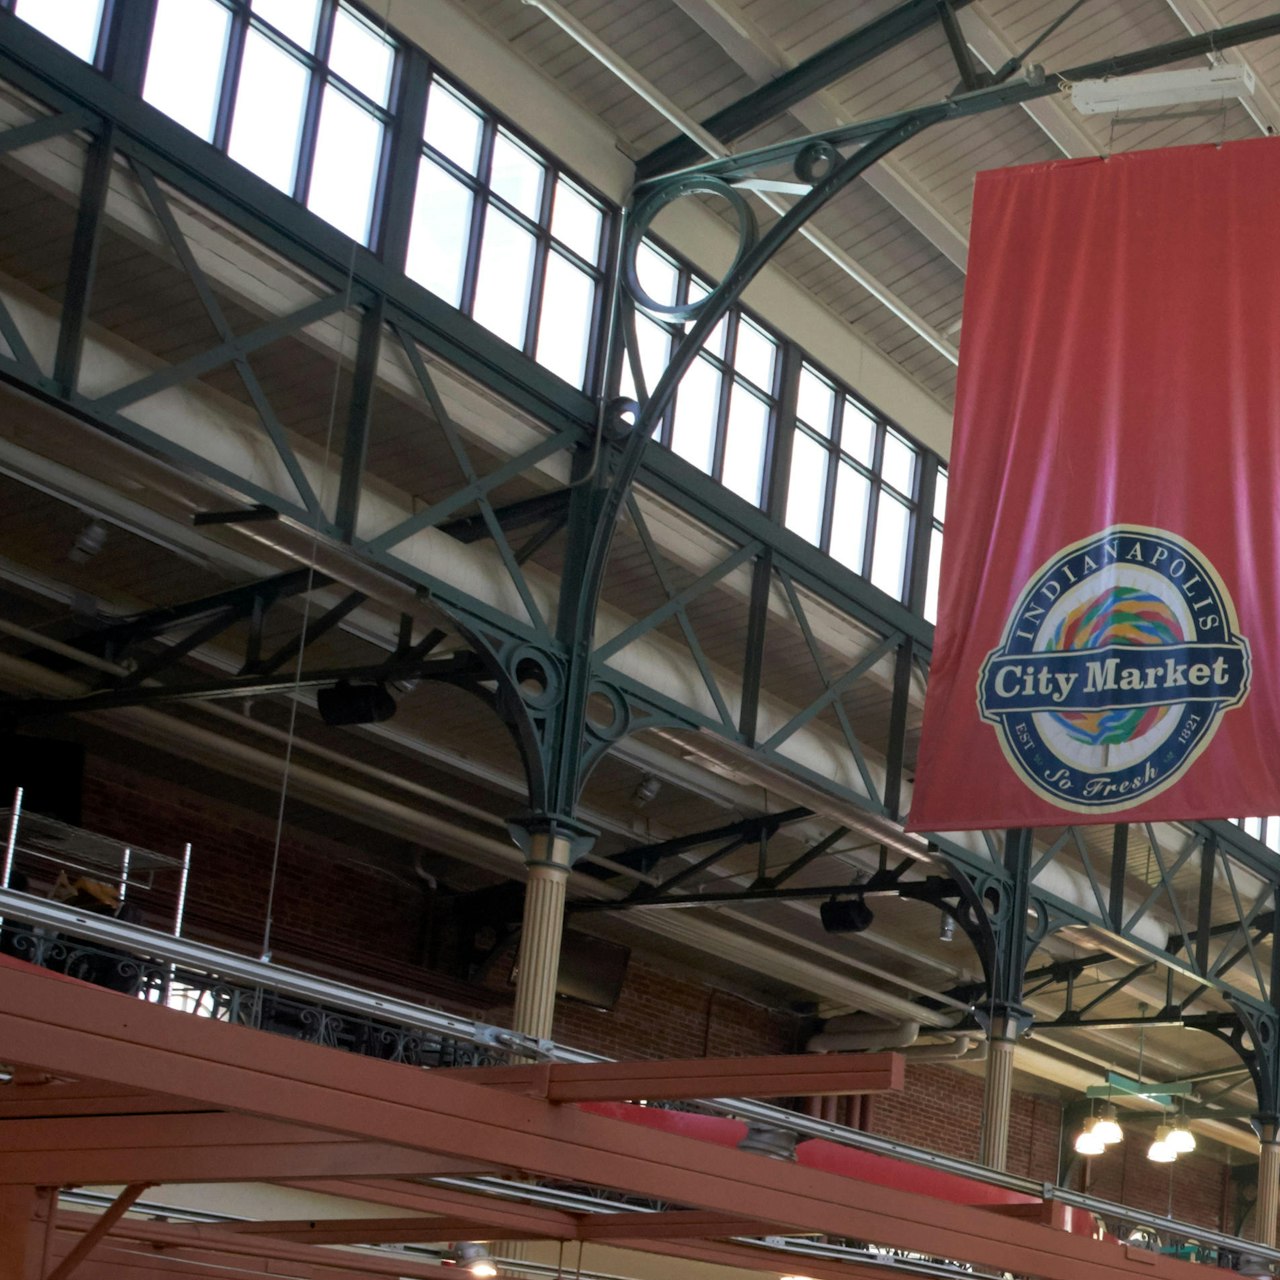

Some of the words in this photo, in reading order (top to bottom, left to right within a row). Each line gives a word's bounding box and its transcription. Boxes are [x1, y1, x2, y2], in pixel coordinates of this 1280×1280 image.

[1016, 540, 1221, 642] INDIANAPOLIS
[994, 664, 1079, 702] City
[1085, 656, 1229, 694] Market
[1015, 721, 1036, 752] EST
[1177, 713, 1201, 746] 1821
[1043, 767, 1073, 791] So
[1083, 762, 1159, 799] Fresh
